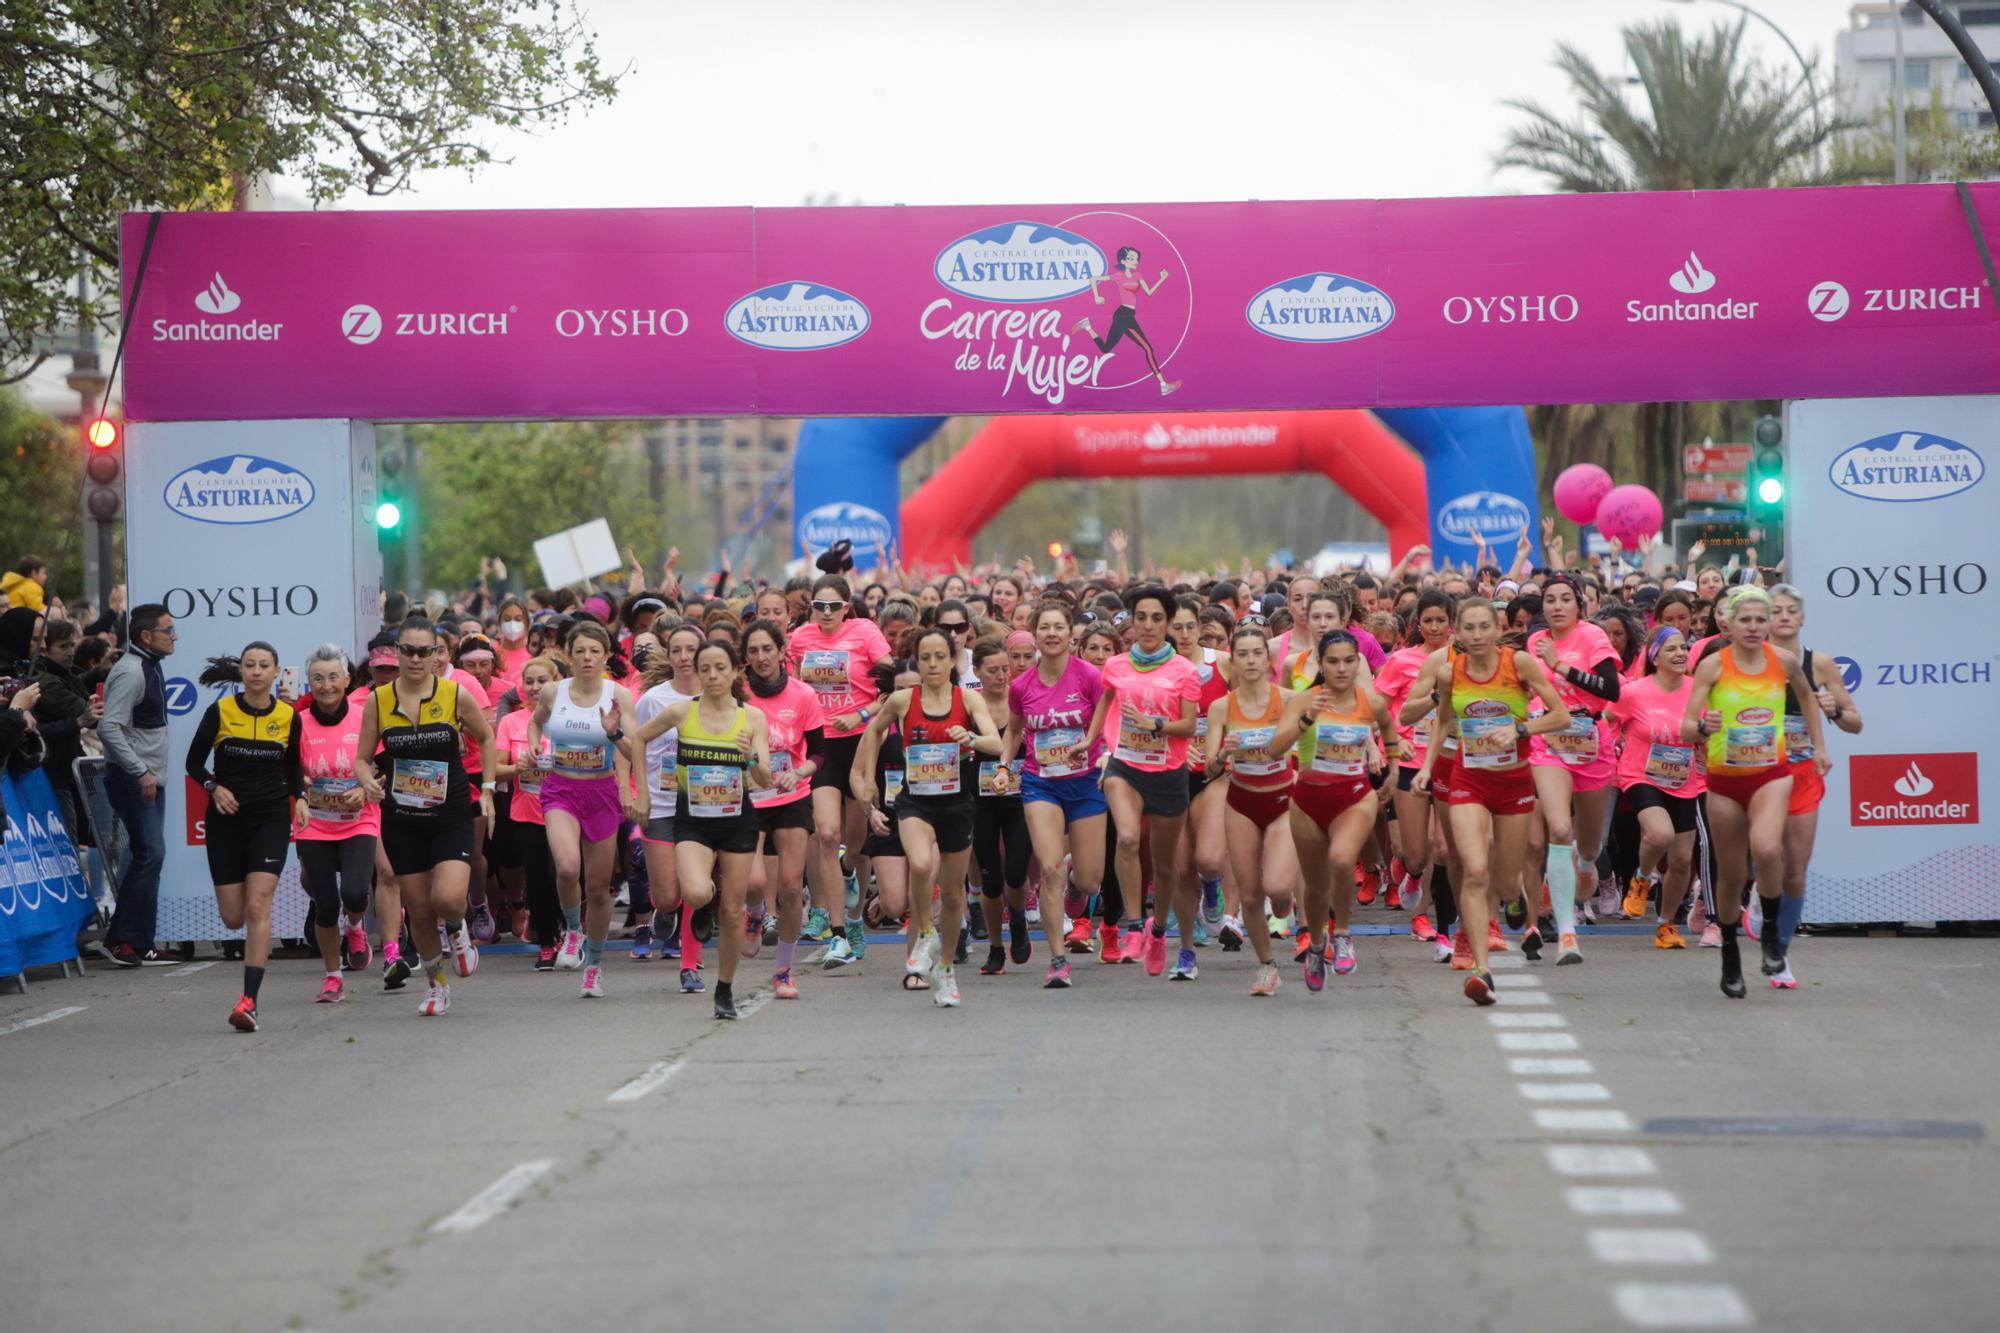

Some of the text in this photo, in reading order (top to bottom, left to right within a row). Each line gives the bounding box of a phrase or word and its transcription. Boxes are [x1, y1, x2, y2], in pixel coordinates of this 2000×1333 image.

[974, 249, 1089, 258] CENTRAL LECHERA
[947, 251, 1094, 282] ASTURIANA
[1443, 294, 1579, 324] OYSHO
[1626, 298, 1760, 323] Santander
[1863, 286, 1982, 312] ZURICH
[555, 308, 689, 337] OYSHO
[736, 307, 859, 333] ASTURIANA
[920, 298, 1062, 340] Carrera
[1258, 299, 1383, 325] ASTURIANA
[153, 319, 284, 342] Santander
[396, 312, 508, 336] ZURICH
[955, 335, 1115, 405] de la Mujer
[1074, 422, 1279, 454] Sports Santander
[1864, 454, 1969, 464] CENTRAL LECHERA
[198, 479, 245, 487] CENTRAL
[1841, 459, 1973, 485] ASTURIANA
[176, 481, 303, 508] ASTURIANA
[1826, 562, 1987, 598] OYSHO
[162, 584, 318, 619] OYSHO
[814, 667, 835, 676] 016
[1877, 662, 1991, 686] ZURICH
[418, 730, 450, 740] RUNNERS
[564, 719, 591, 730] Delta
[1130, 733, 1151, 743] 016
[1331, 743, 1354, 753] 016
[1560, 735, 1582, 744] 016
[566, 751, 589, 760] 016
[1660, 762, 1681, 772] 016
[921, 763, 945, 773] 016
[409, 776, 431, 788] 016
[703, 785, 727, 795] 016
[1858, 800, 1970, 821] Santander
